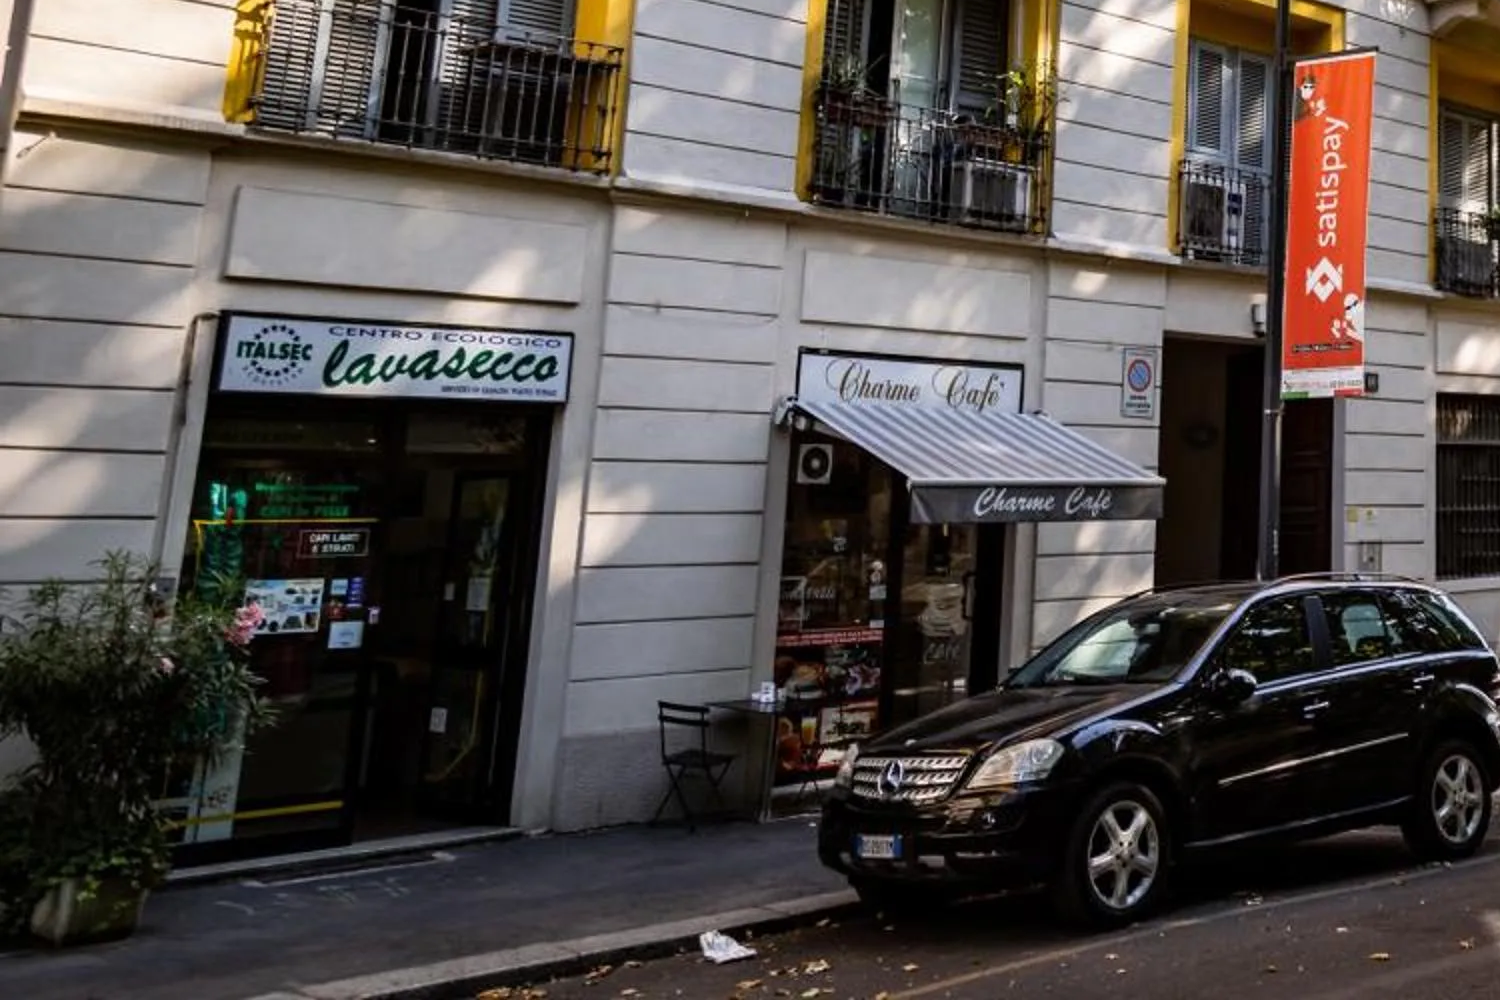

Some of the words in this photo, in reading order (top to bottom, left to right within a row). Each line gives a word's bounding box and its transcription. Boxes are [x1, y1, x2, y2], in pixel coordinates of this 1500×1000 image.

[1315, 116, 1350, 247] satispay
[236, 340, 314, 361] ITALSEC
[328, 325, 423, 341] CENTRO
[431, 332, 562, 349] ECOLOGICO
[322, 339, 560, 388] lavasecco
[825, 358, 922, 402] Charme
[973, 487, 1056, 517] Charme
